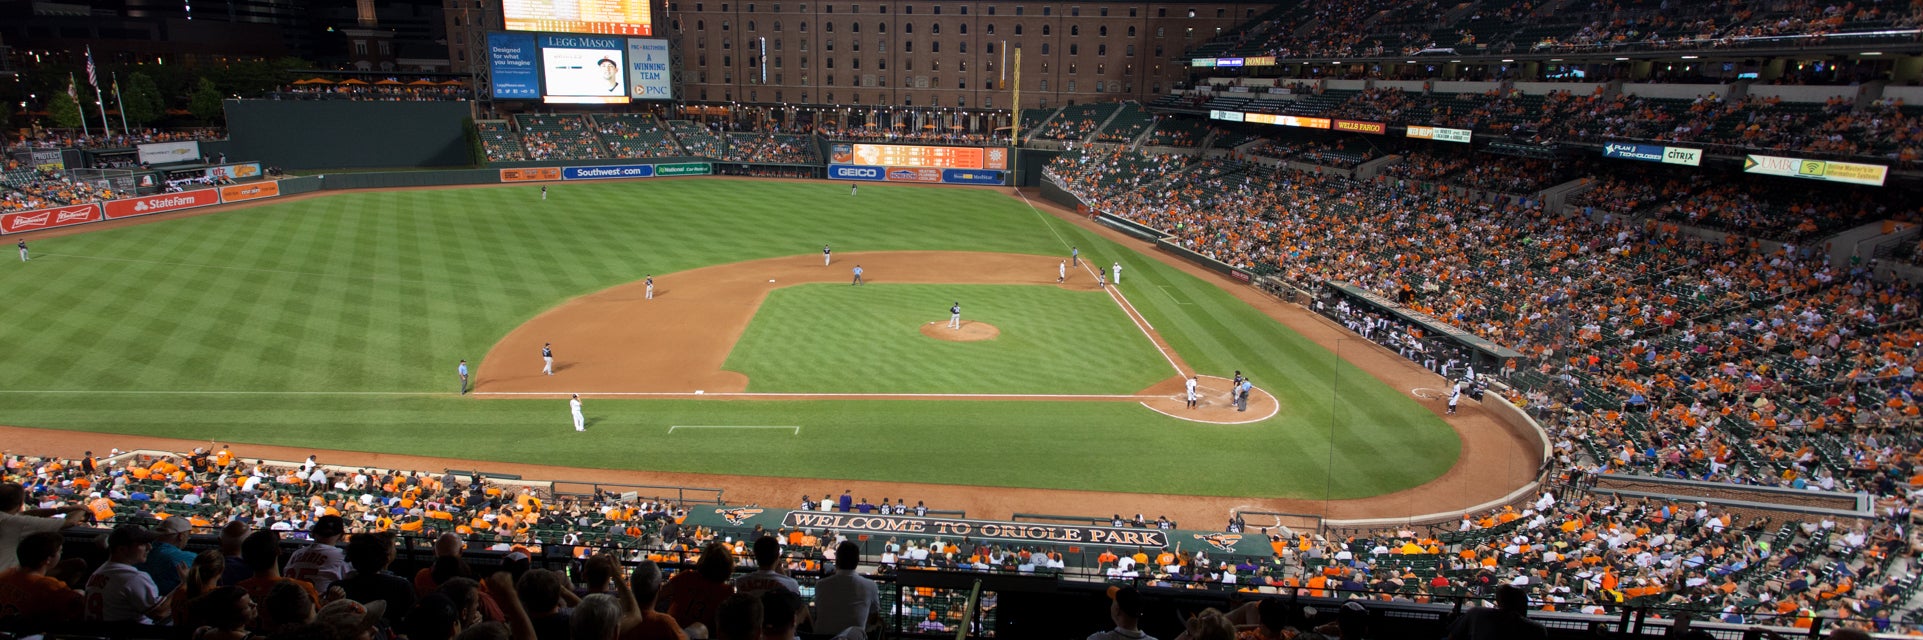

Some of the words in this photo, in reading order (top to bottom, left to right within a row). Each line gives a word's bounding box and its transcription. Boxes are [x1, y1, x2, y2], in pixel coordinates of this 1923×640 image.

[549, 36, 576, 47] LEGG
[579, 37, 615, 48] MASON
[646, 53, 652, 61] A
[1245, 57, 1265, 66] ROMA
[633, 62, 666, 71] WINNING
[640, 72, 660, 80] TEAM
[646, 86, 667, 95] PNC
[1338, 121, 1359, 130] WELLS
[1360, 123, 1381, 132] FARGO
[33, 152, 60, 160] PROTECT
[1619, 151, 1662, 160] TECHNOLOGIES
[1761, 157, 1800, 172] UMBC
[837, 167, 877, 177] GEICO
[793, 513, 926, 533] WELCOME
[934, 521, 972, 535] TO
[980, 523, 1082, 541] ORIOLE
[1089, 529, 1163, 546] PARK
[1038, 557, 1043, 566] 5
